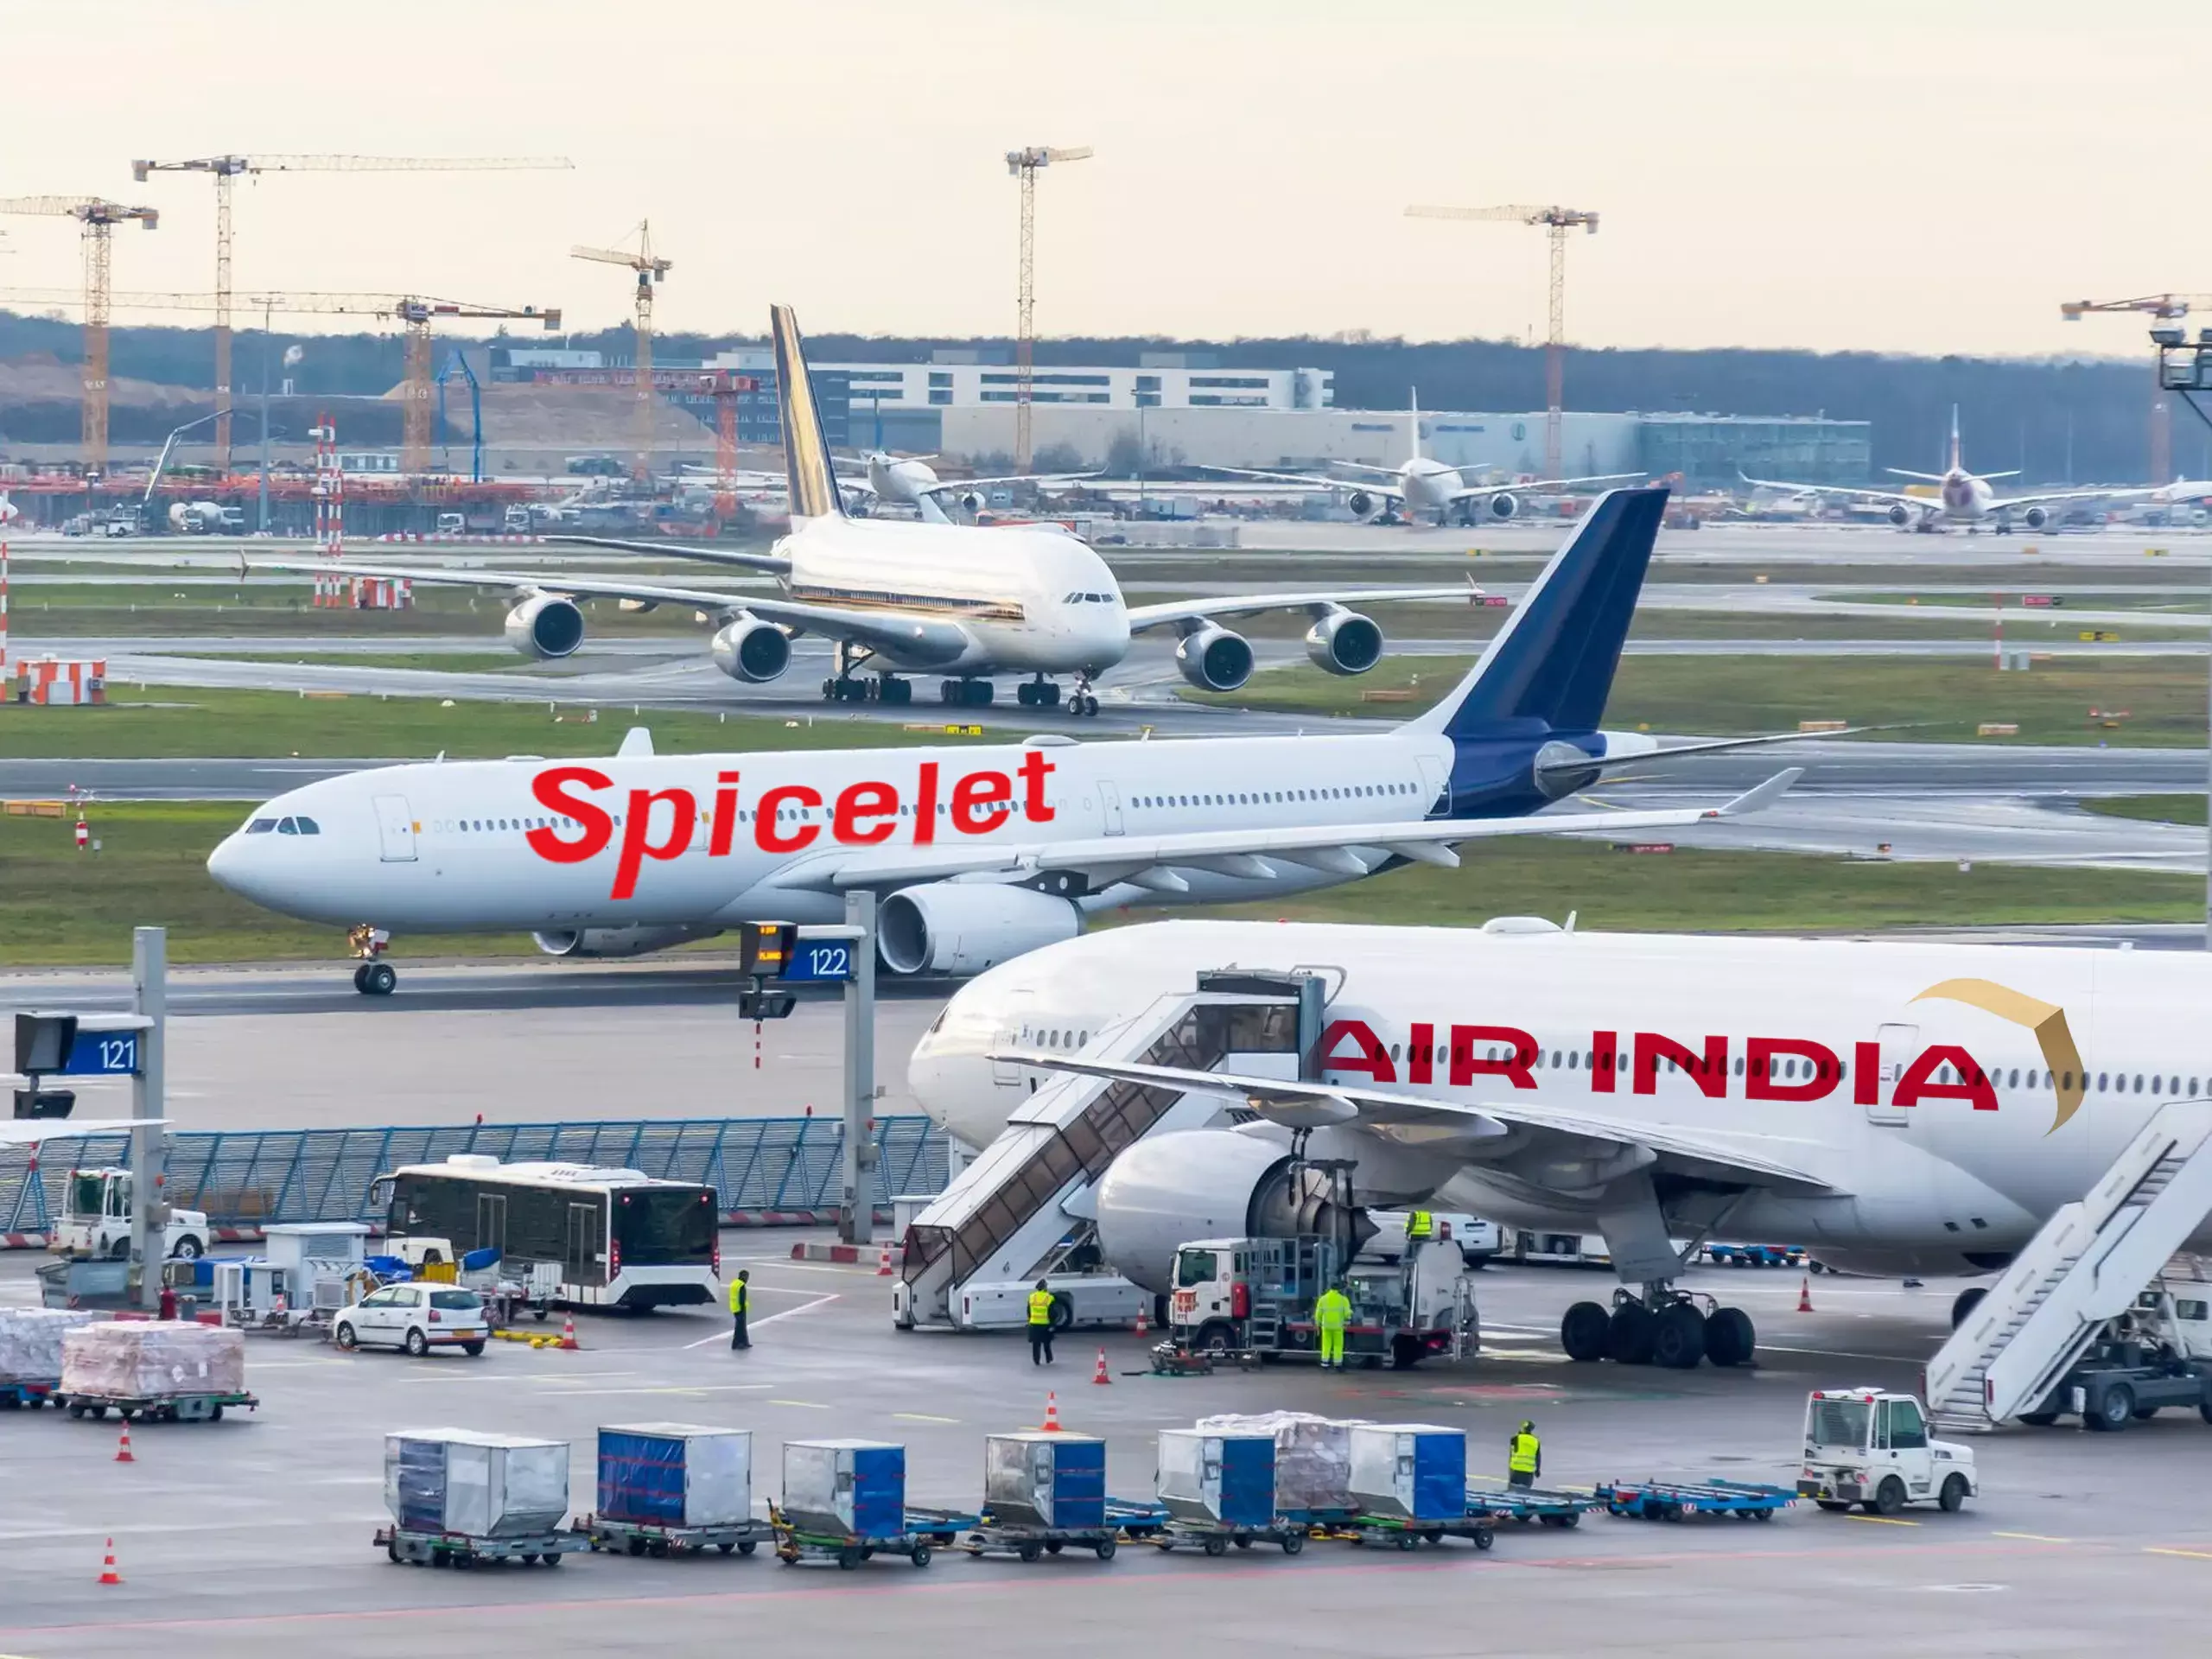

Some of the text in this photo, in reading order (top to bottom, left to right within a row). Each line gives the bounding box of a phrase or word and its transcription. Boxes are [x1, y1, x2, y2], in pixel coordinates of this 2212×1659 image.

[809, 948, 847, 976] 122
[99, 1039, 134, 1069] 121
[1305, 1019, 1999, 1111] AIR INDIA
